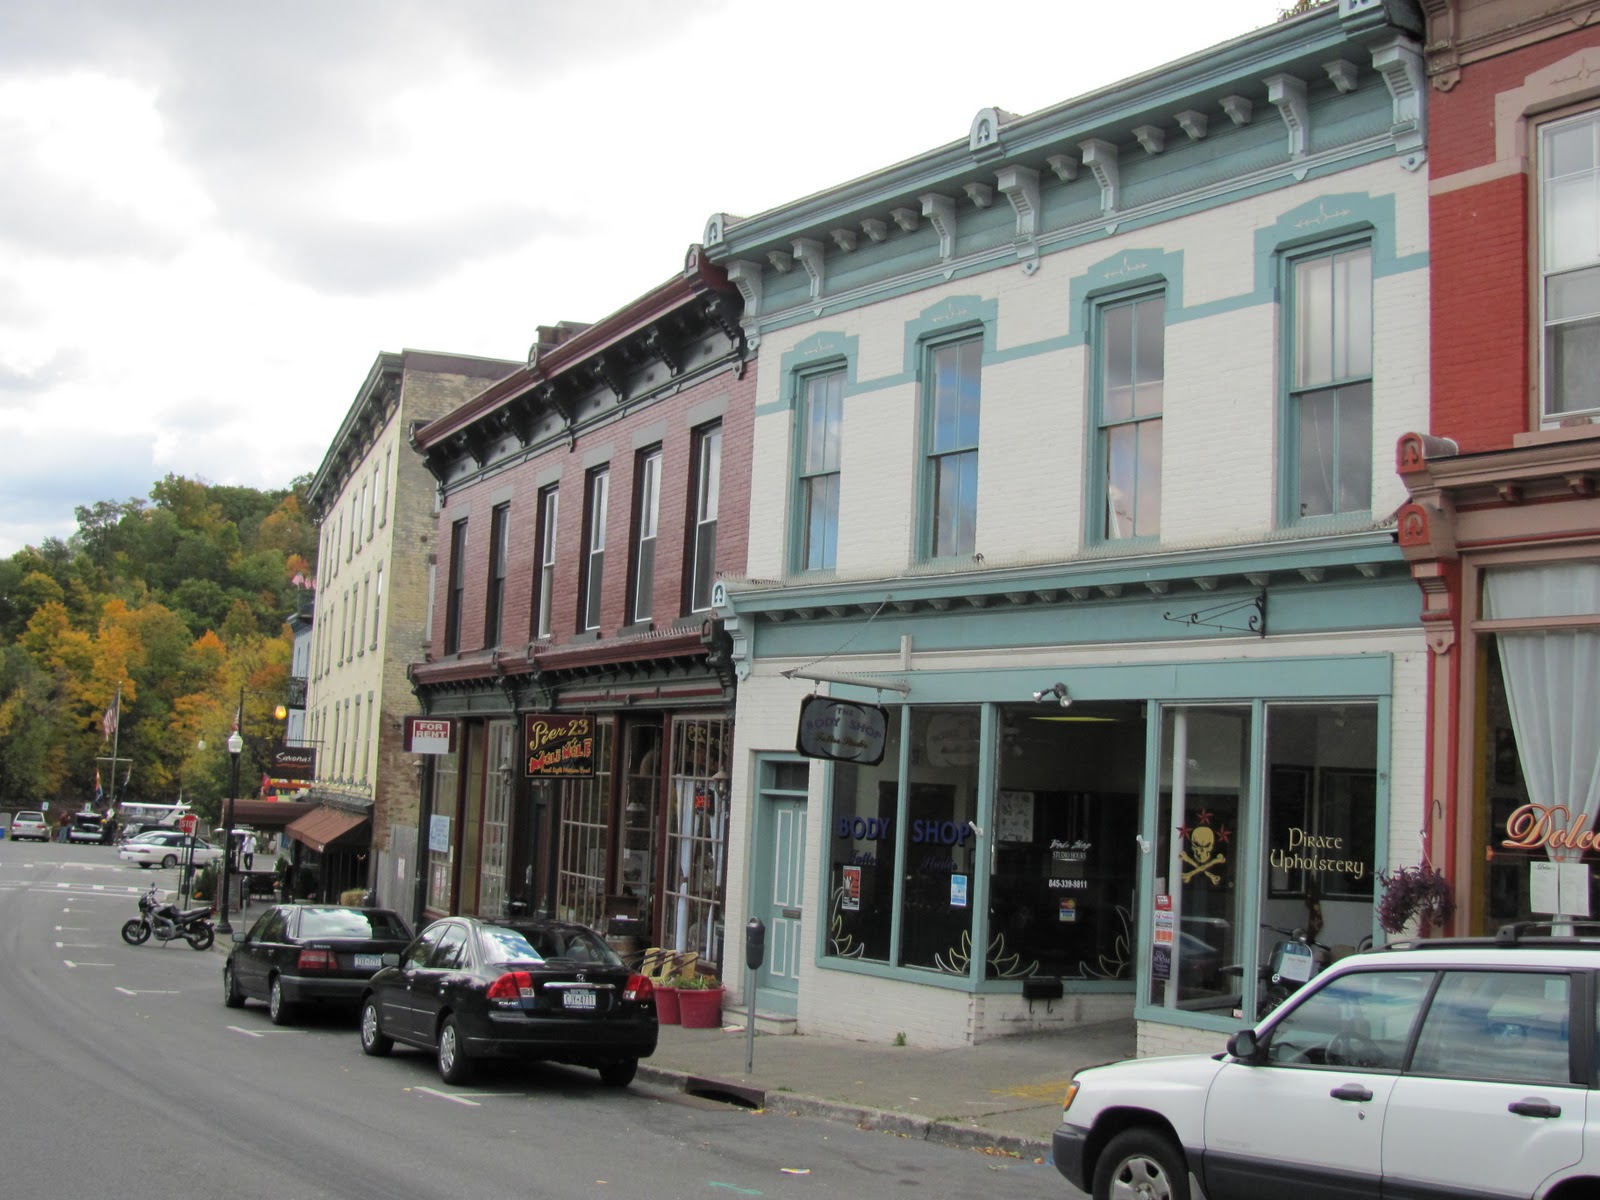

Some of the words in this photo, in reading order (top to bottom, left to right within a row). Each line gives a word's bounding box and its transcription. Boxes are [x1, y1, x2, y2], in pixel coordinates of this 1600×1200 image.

[416, 730, 447, 738] RENT
[420, 723, 443, 731] FOR
[530, 721, 567, 750] Pier
[568, 719, 589, 736] 23
[848, 720, 882, 739] SHOP
[837, 816, 891, 840] BODY
[912, 819, 970, 847] SHOP
[1288, 827, 1342, 851] Pirate
[1053, 851, 1070, 859] STUDIO
[1071, 851, 1087, 859] HOURS
[1270, 848, 1364, 880] Upholstery
